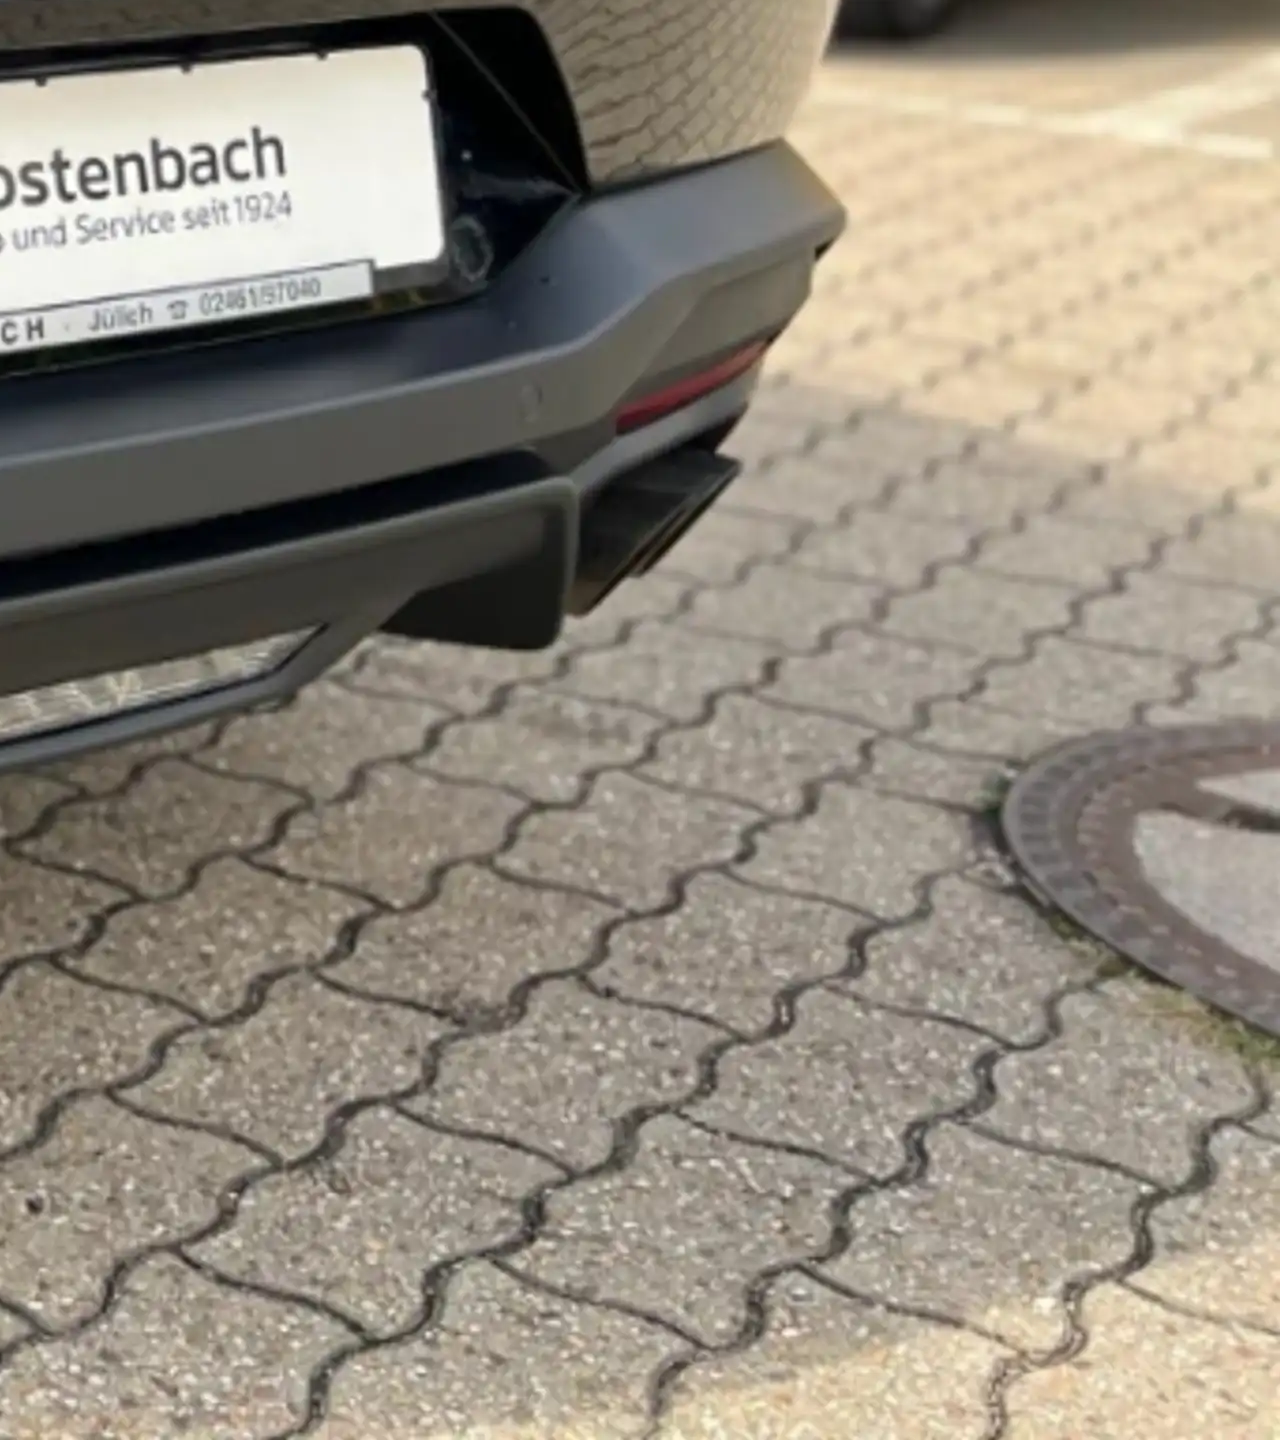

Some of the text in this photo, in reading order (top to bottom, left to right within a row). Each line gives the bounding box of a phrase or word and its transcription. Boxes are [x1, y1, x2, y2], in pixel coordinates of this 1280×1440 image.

[12, 216, 68, 251] und
[74, 207, 176, 245] Service
[182, 198, 231, 231] seit
[234, 190, 293, 224] 1924
[87, 301, 153, 332] Jülich
